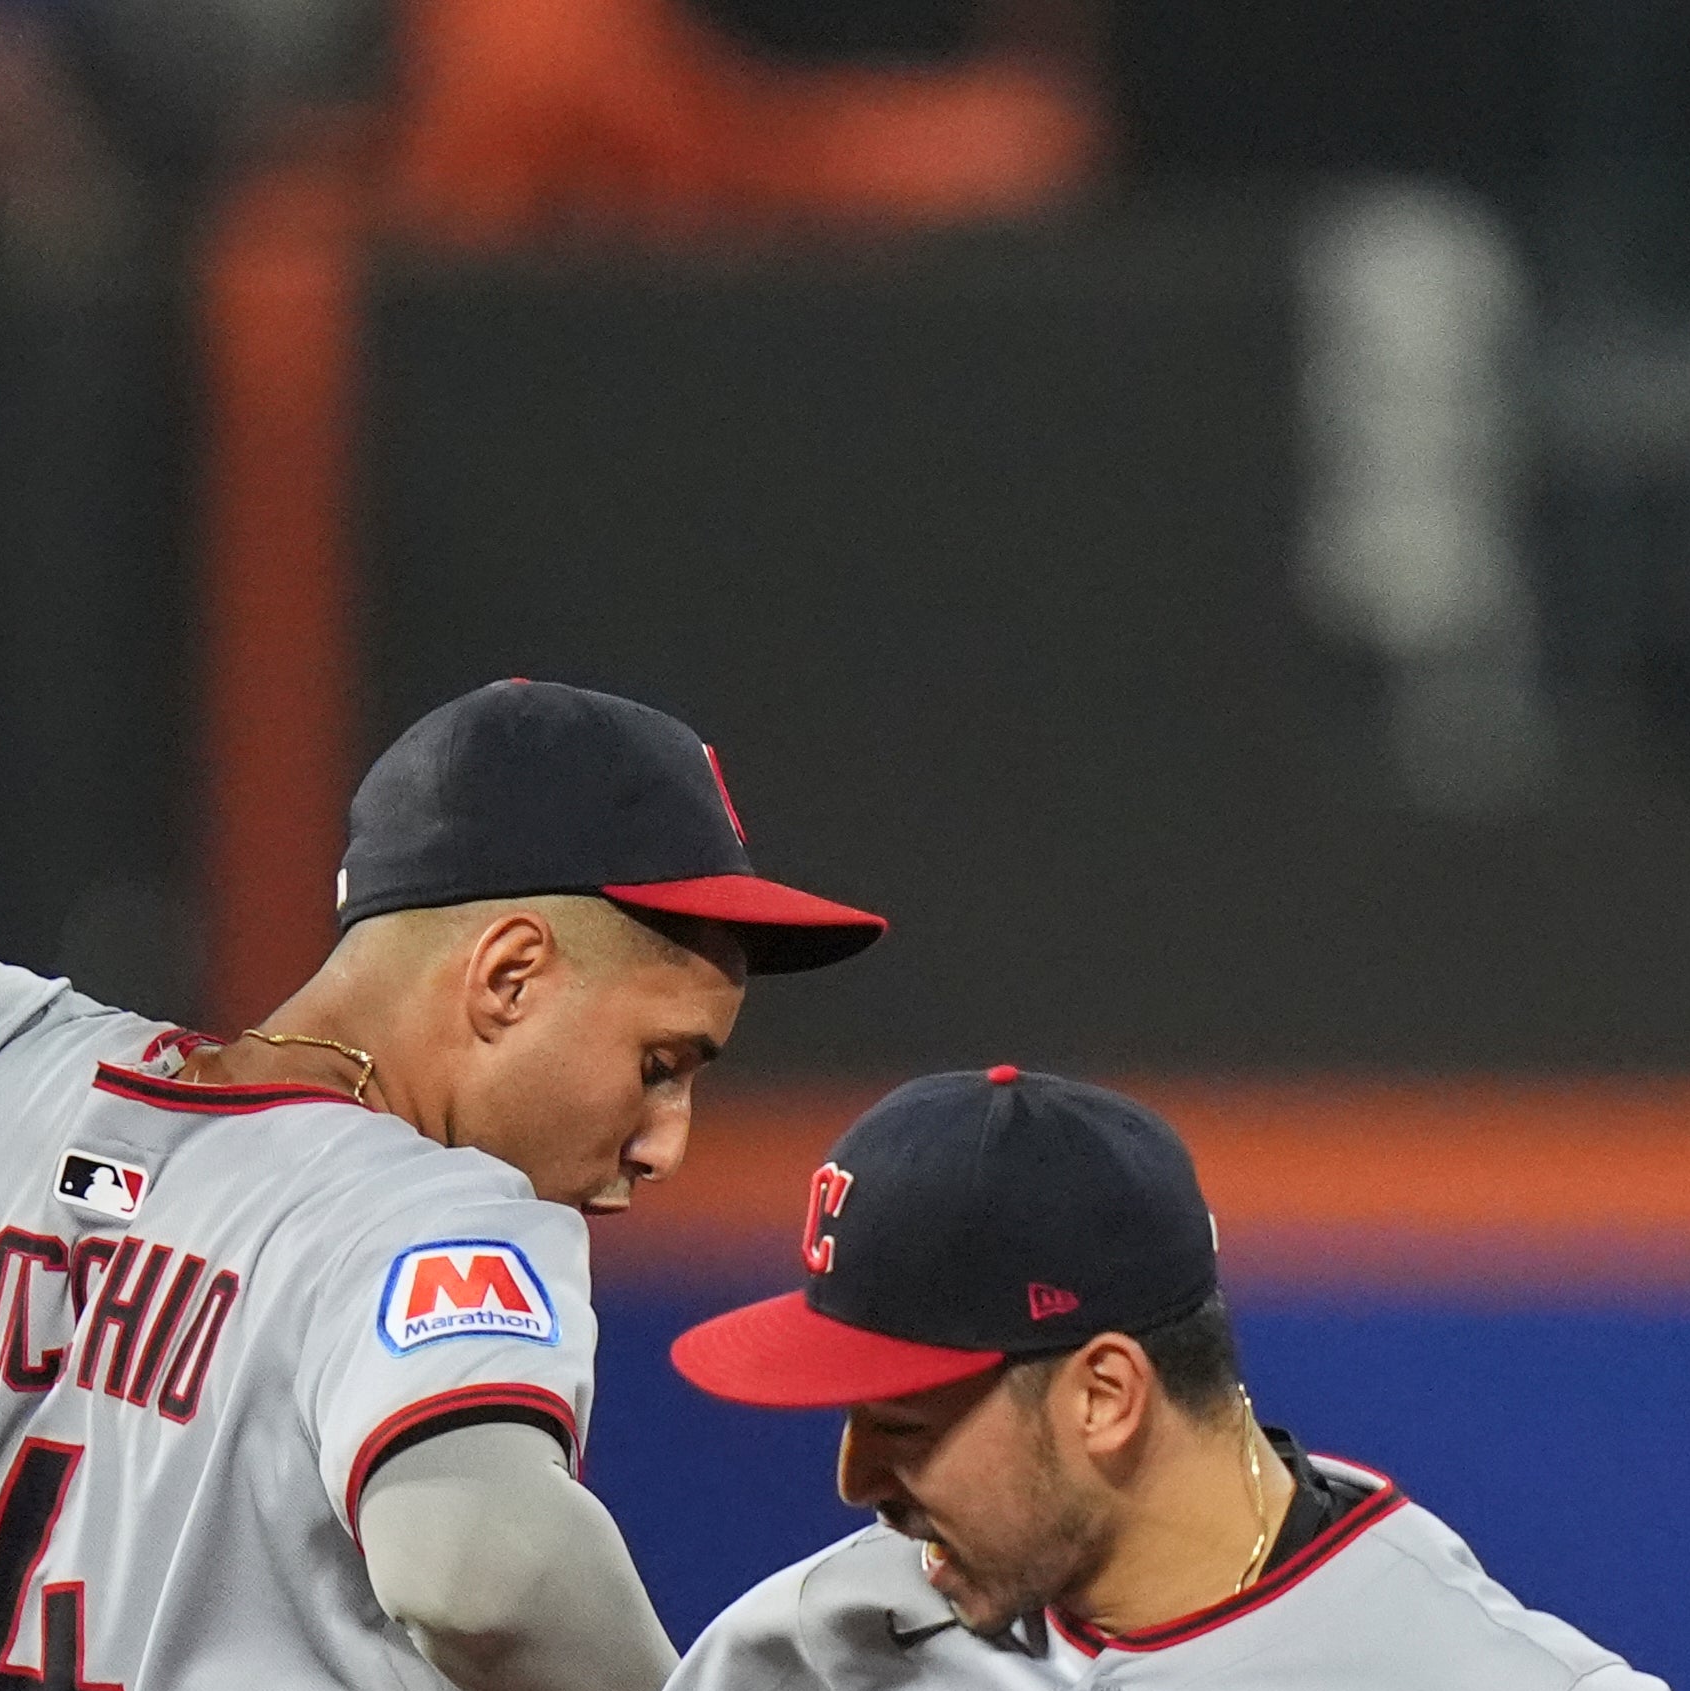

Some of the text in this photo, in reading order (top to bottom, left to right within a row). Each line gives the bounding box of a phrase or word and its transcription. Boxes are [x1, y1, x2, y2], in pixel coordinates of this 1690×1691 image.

[802, 1161, 854, 1274] C
[405, 1255, 533, 1320] M
[404, 1310, 541, 1340] Marathon
